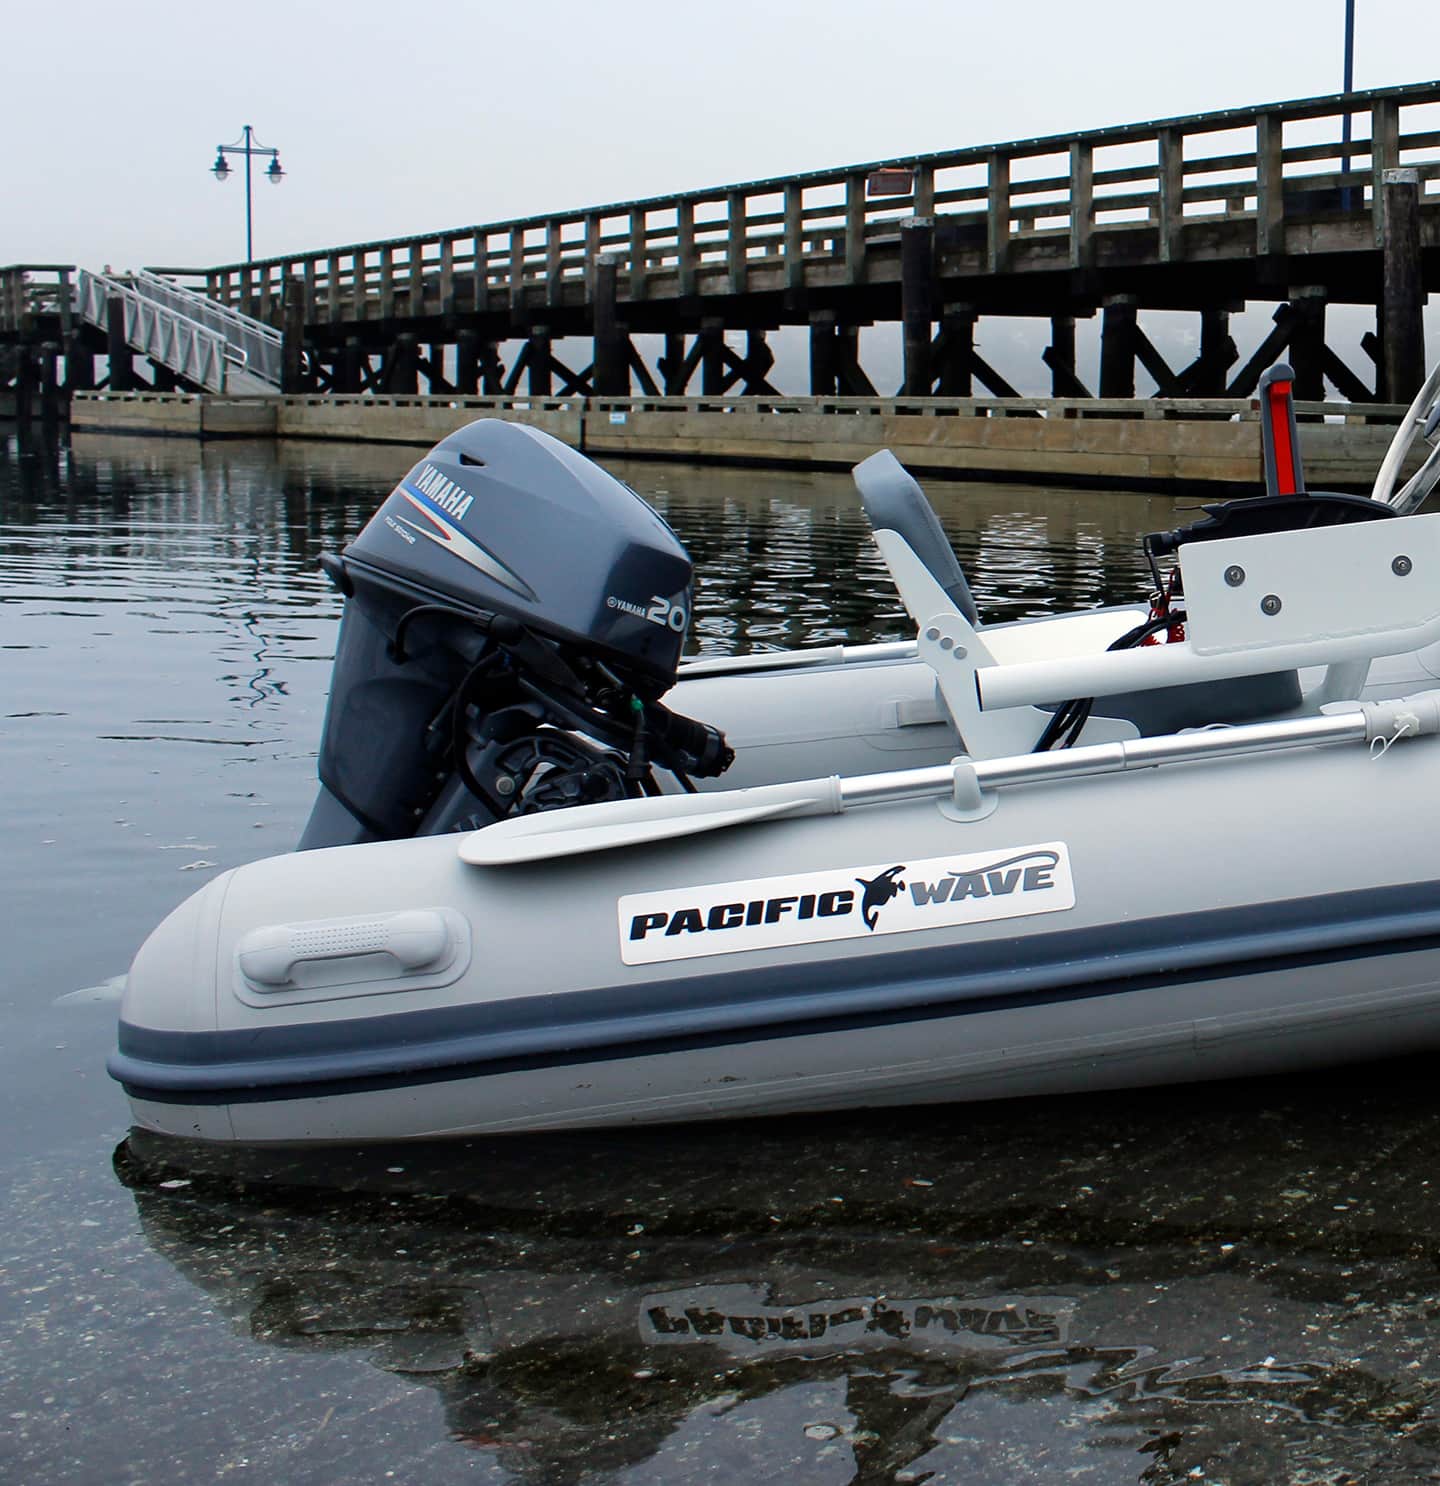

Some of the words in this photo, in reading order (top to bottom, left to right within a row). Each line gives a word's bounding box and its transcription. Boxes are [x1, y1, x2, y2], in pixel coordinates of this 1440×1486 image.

[415, 464, 474, 520] YAMAHA
[617, 600, 646, 618] YAMAHA
[647, 595, 687, 632] 20
[630, 890, 855, 940] PACIFIC
[911, 858, 1058, 906] WAVE
